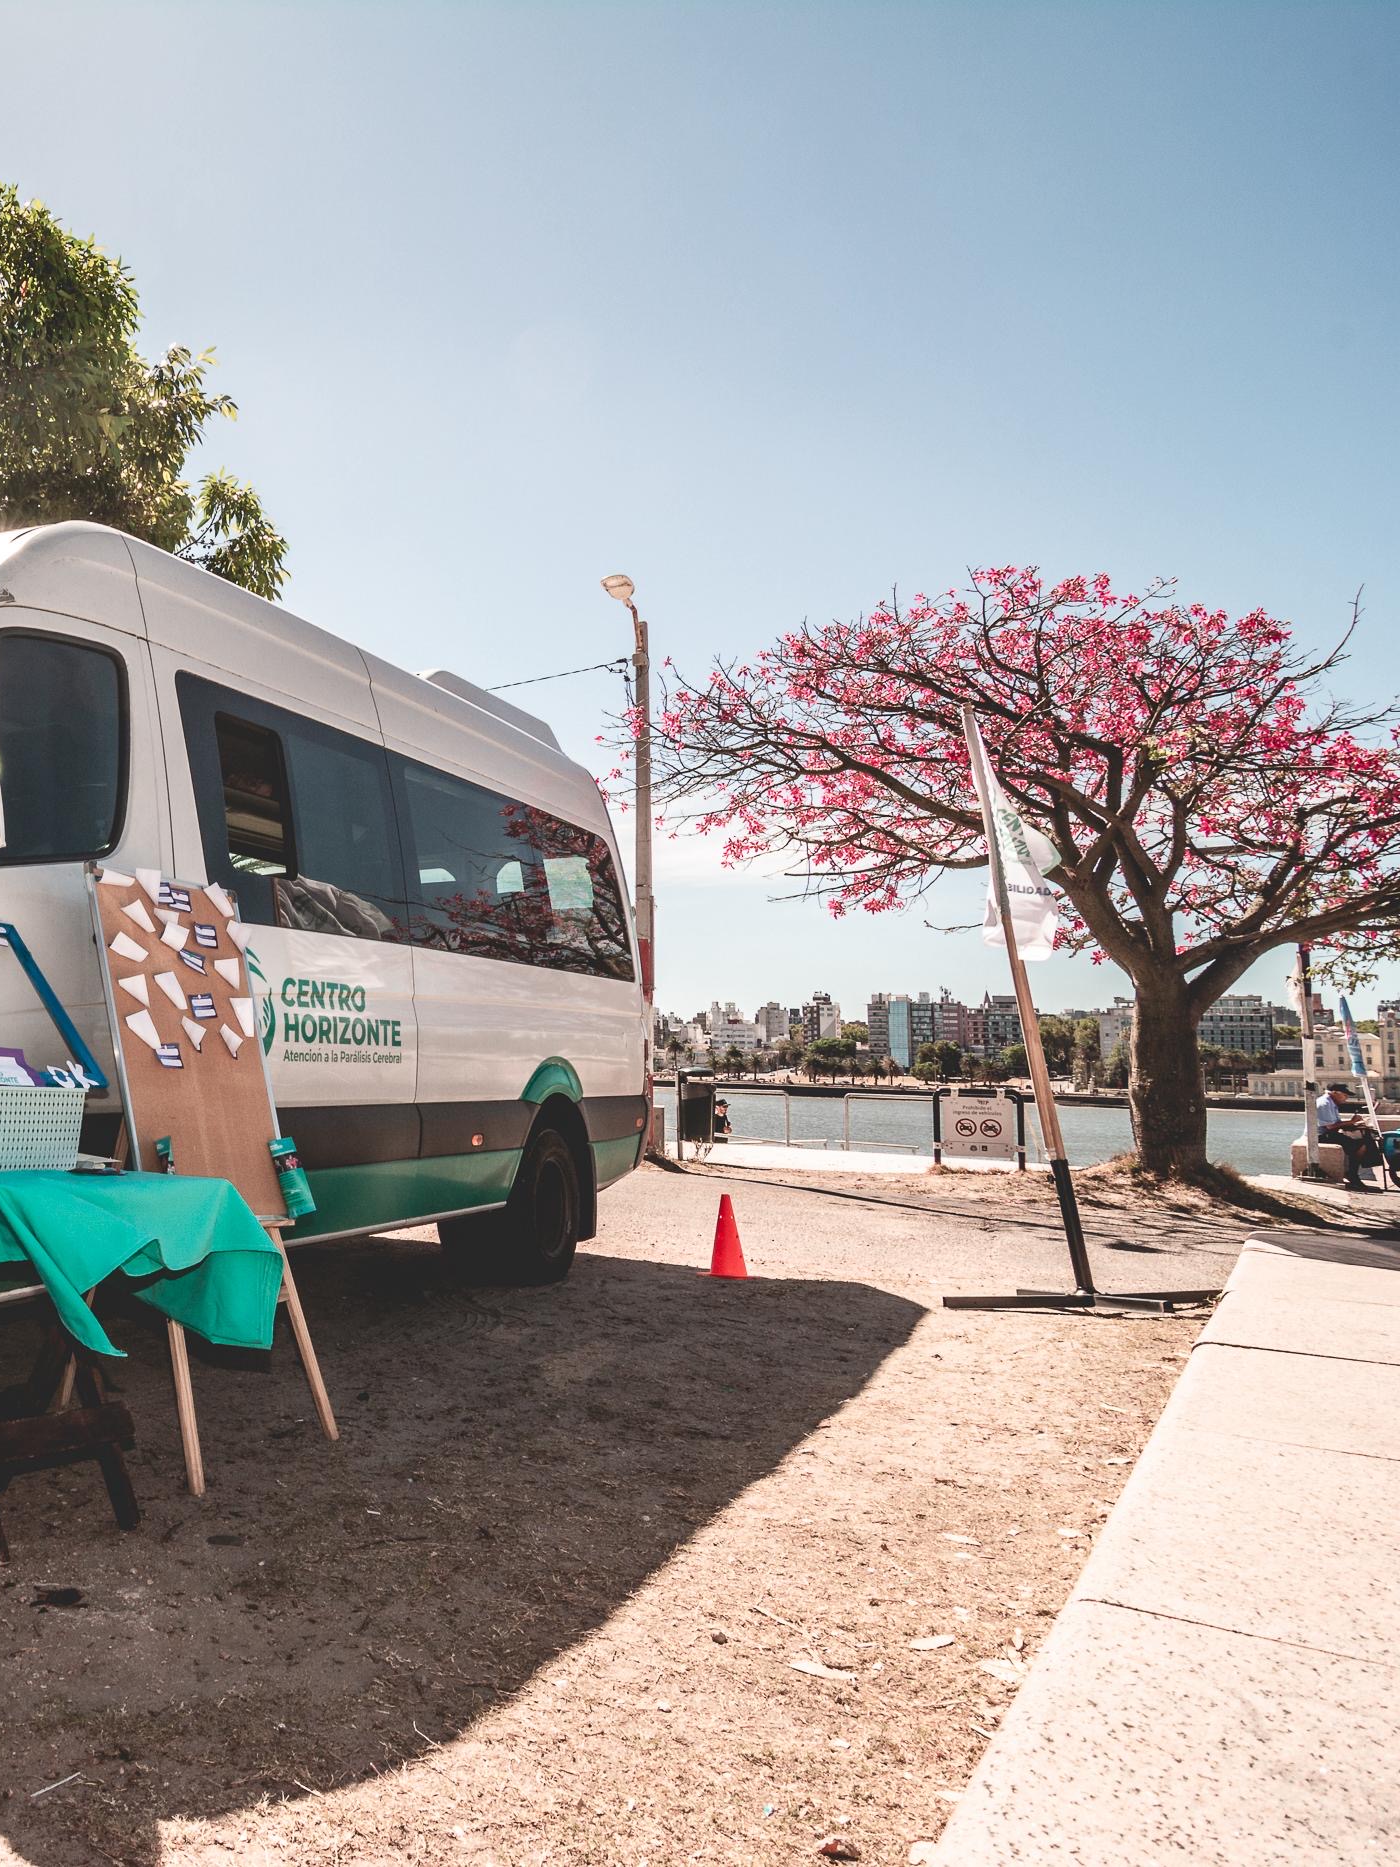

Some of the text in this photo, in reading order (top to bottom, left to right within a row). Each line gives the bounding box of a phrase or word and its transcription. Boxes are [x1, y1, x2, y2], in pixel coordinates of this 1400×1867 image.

[280, 977, 366, 1012] CENTRO
[283, 1012, 402, 1047] HORIZONTE
[283, 1048, 402, 1064] Atención a la Parálisis Cerebral
